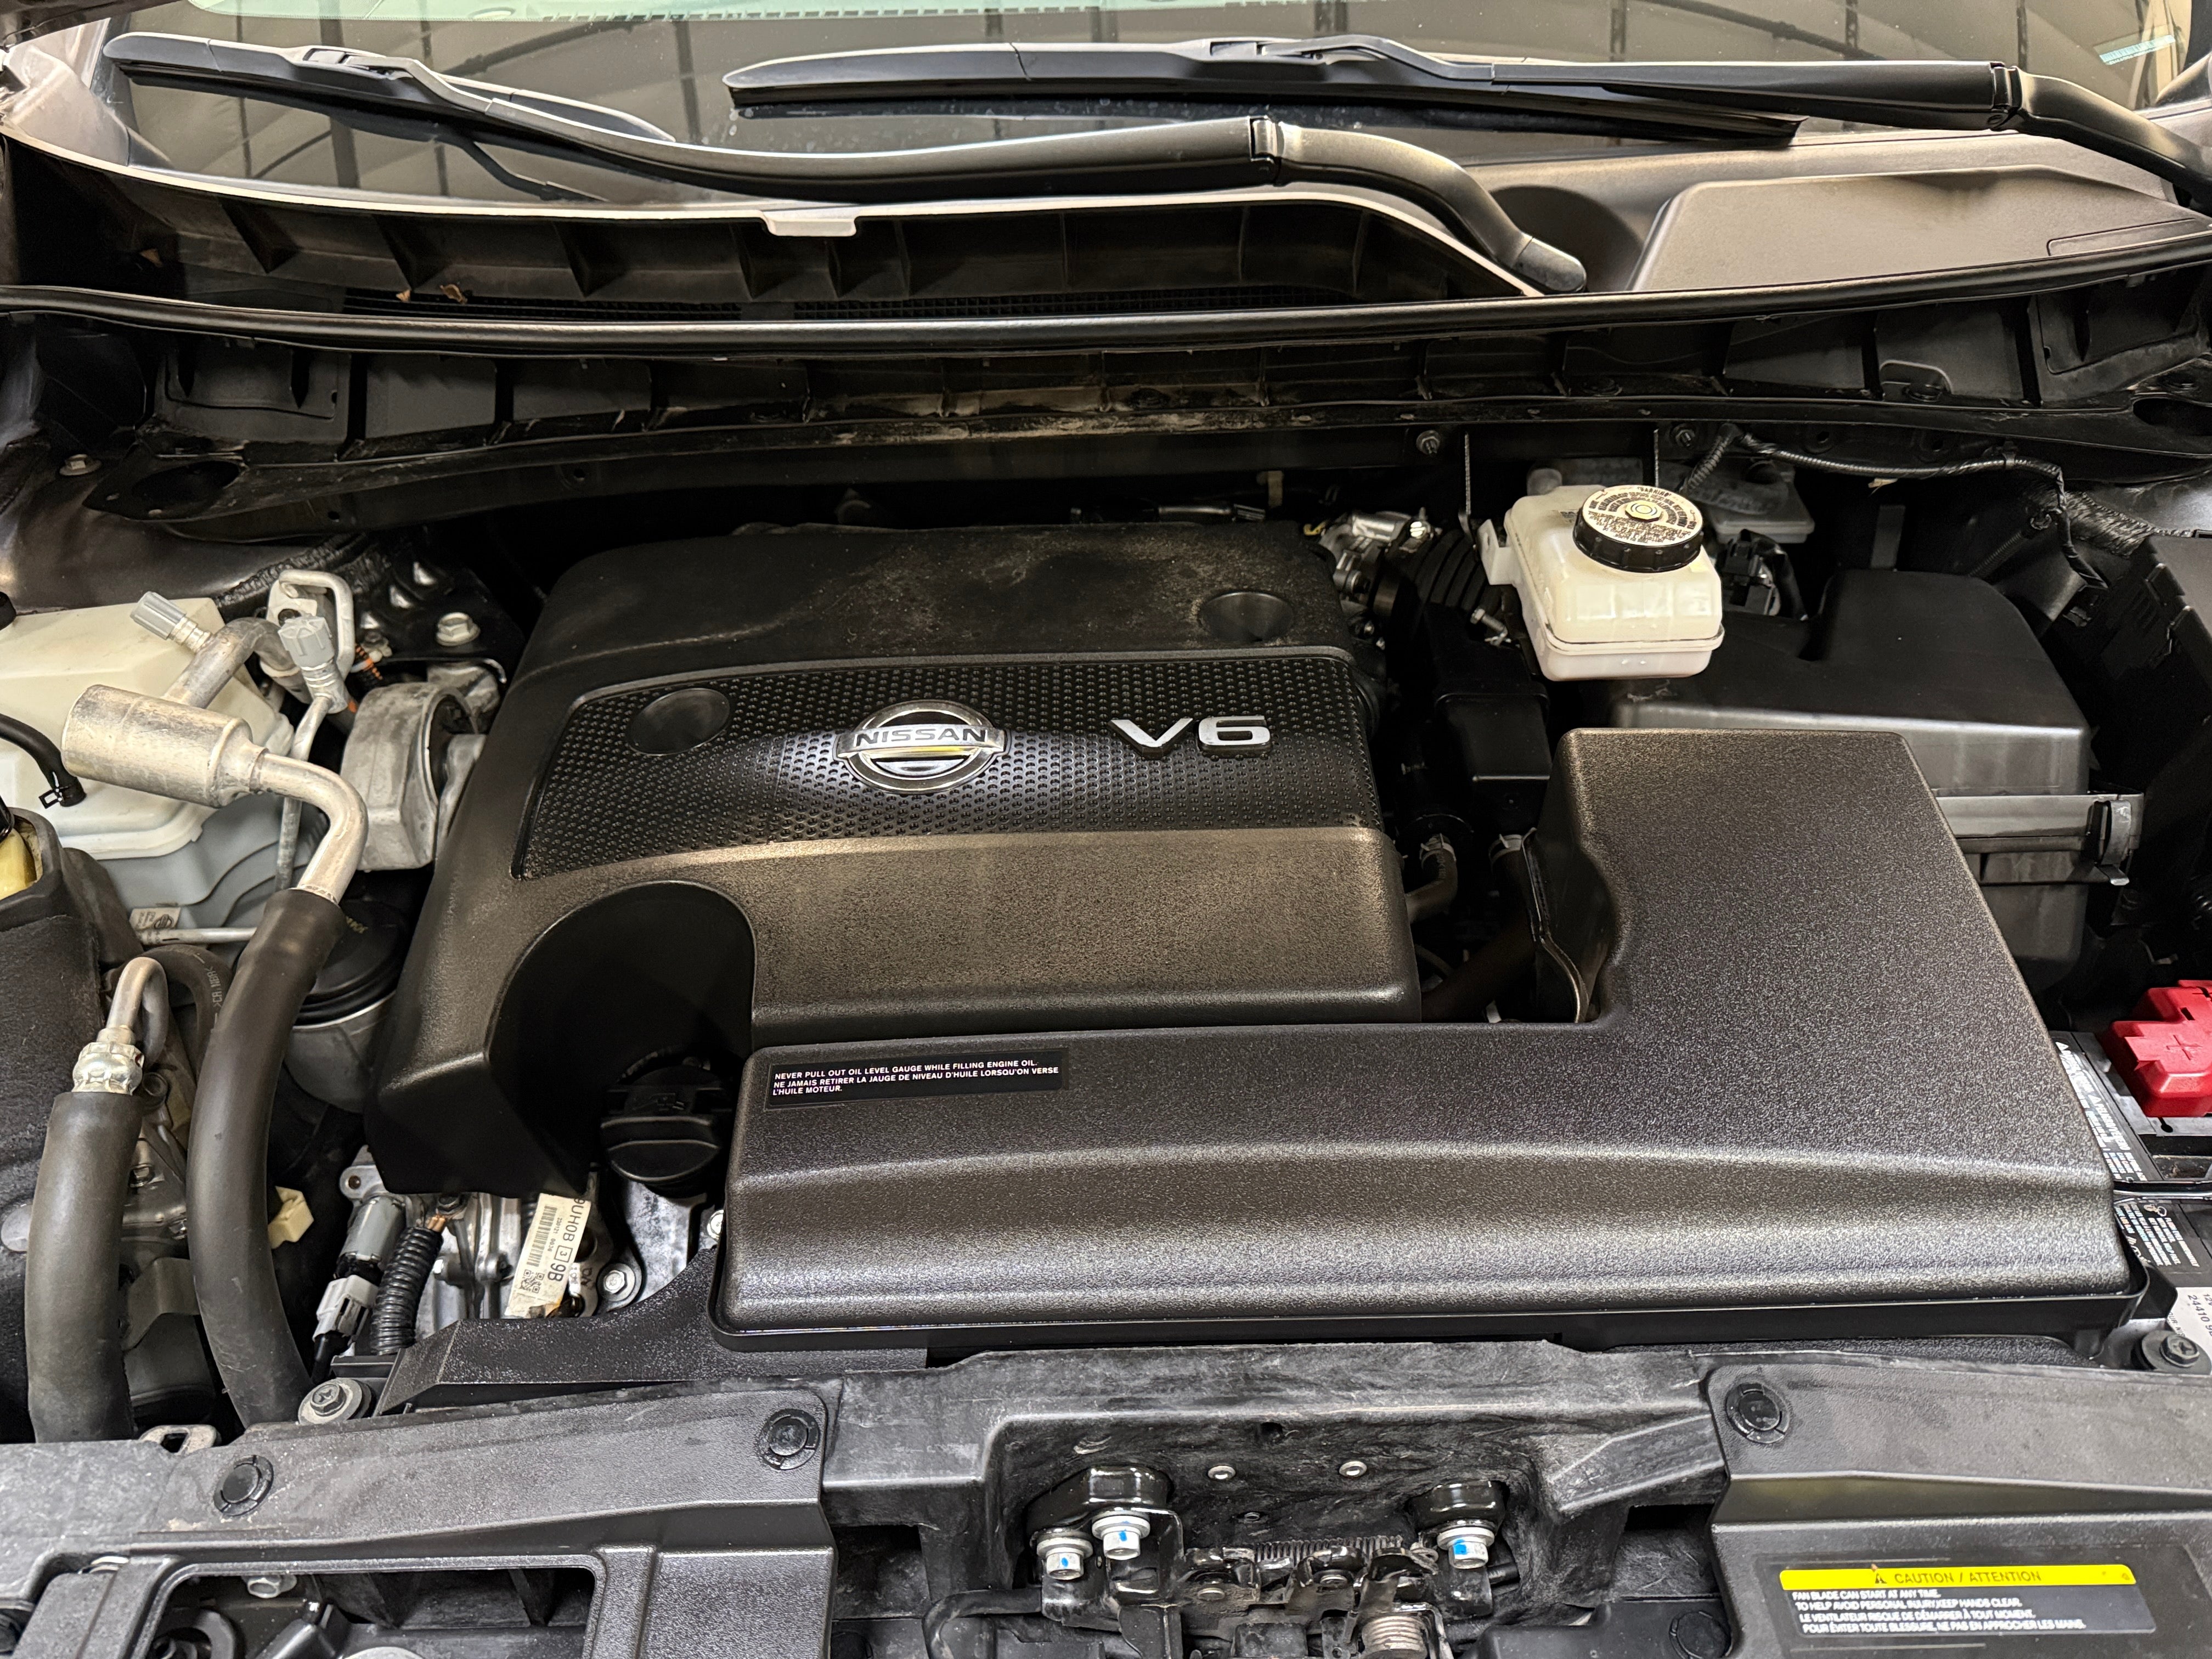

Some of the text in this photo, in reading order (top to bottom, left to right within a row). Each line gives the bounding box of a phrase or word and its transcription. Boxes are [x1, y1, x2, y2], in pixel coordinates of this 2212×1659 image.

[856, 728, 986, 747] NISSAN
[1110, 715, 1271, 752] V6
[980, 1068, 1029, 1077] LORSQU'ON
[805, 1086, 843, 1094] MOTEUR.
[548, 1262, 566, 1282] 9B
[2187, 1294, 2210, 1323] 24410
[1894, 1571, 2041, 1584] CAUTION / ATTENTION
[1792, 1589, 1941, 1600] FAN BLADE CAN START AT ANY TIME.
[1795, 1602, 1809, 1611] TO
[1809, 1601, 1832, 1610] HELP
[1833, 1601, 1860, 1610] AVOID
[1860, 1600, 1907, 1610] PERSONAL
[1959, 1599, 1991, 1607] HANDS
[1990, 1598, 2022, 1607] CLEAR.
[1799, 1613, 1812, 1622] LE
[1812, 1613, 1867, 1623] VENTILATEUR
[1867, 1612, 1901, 1621] RISQUE
[1901, 1612, 1915, 1621] DE
[1970, 1610, 1994, 1620] TOUT
[1803, 1624, 1829, 1633] POUR
[1859, 1623, 1889, 1632] TOUTE
[1950, 1621, 1969, 1630] PAS
[1969, 1621, 1983, 1630] EN
[2037, 1620, 2055, 1629] LES
